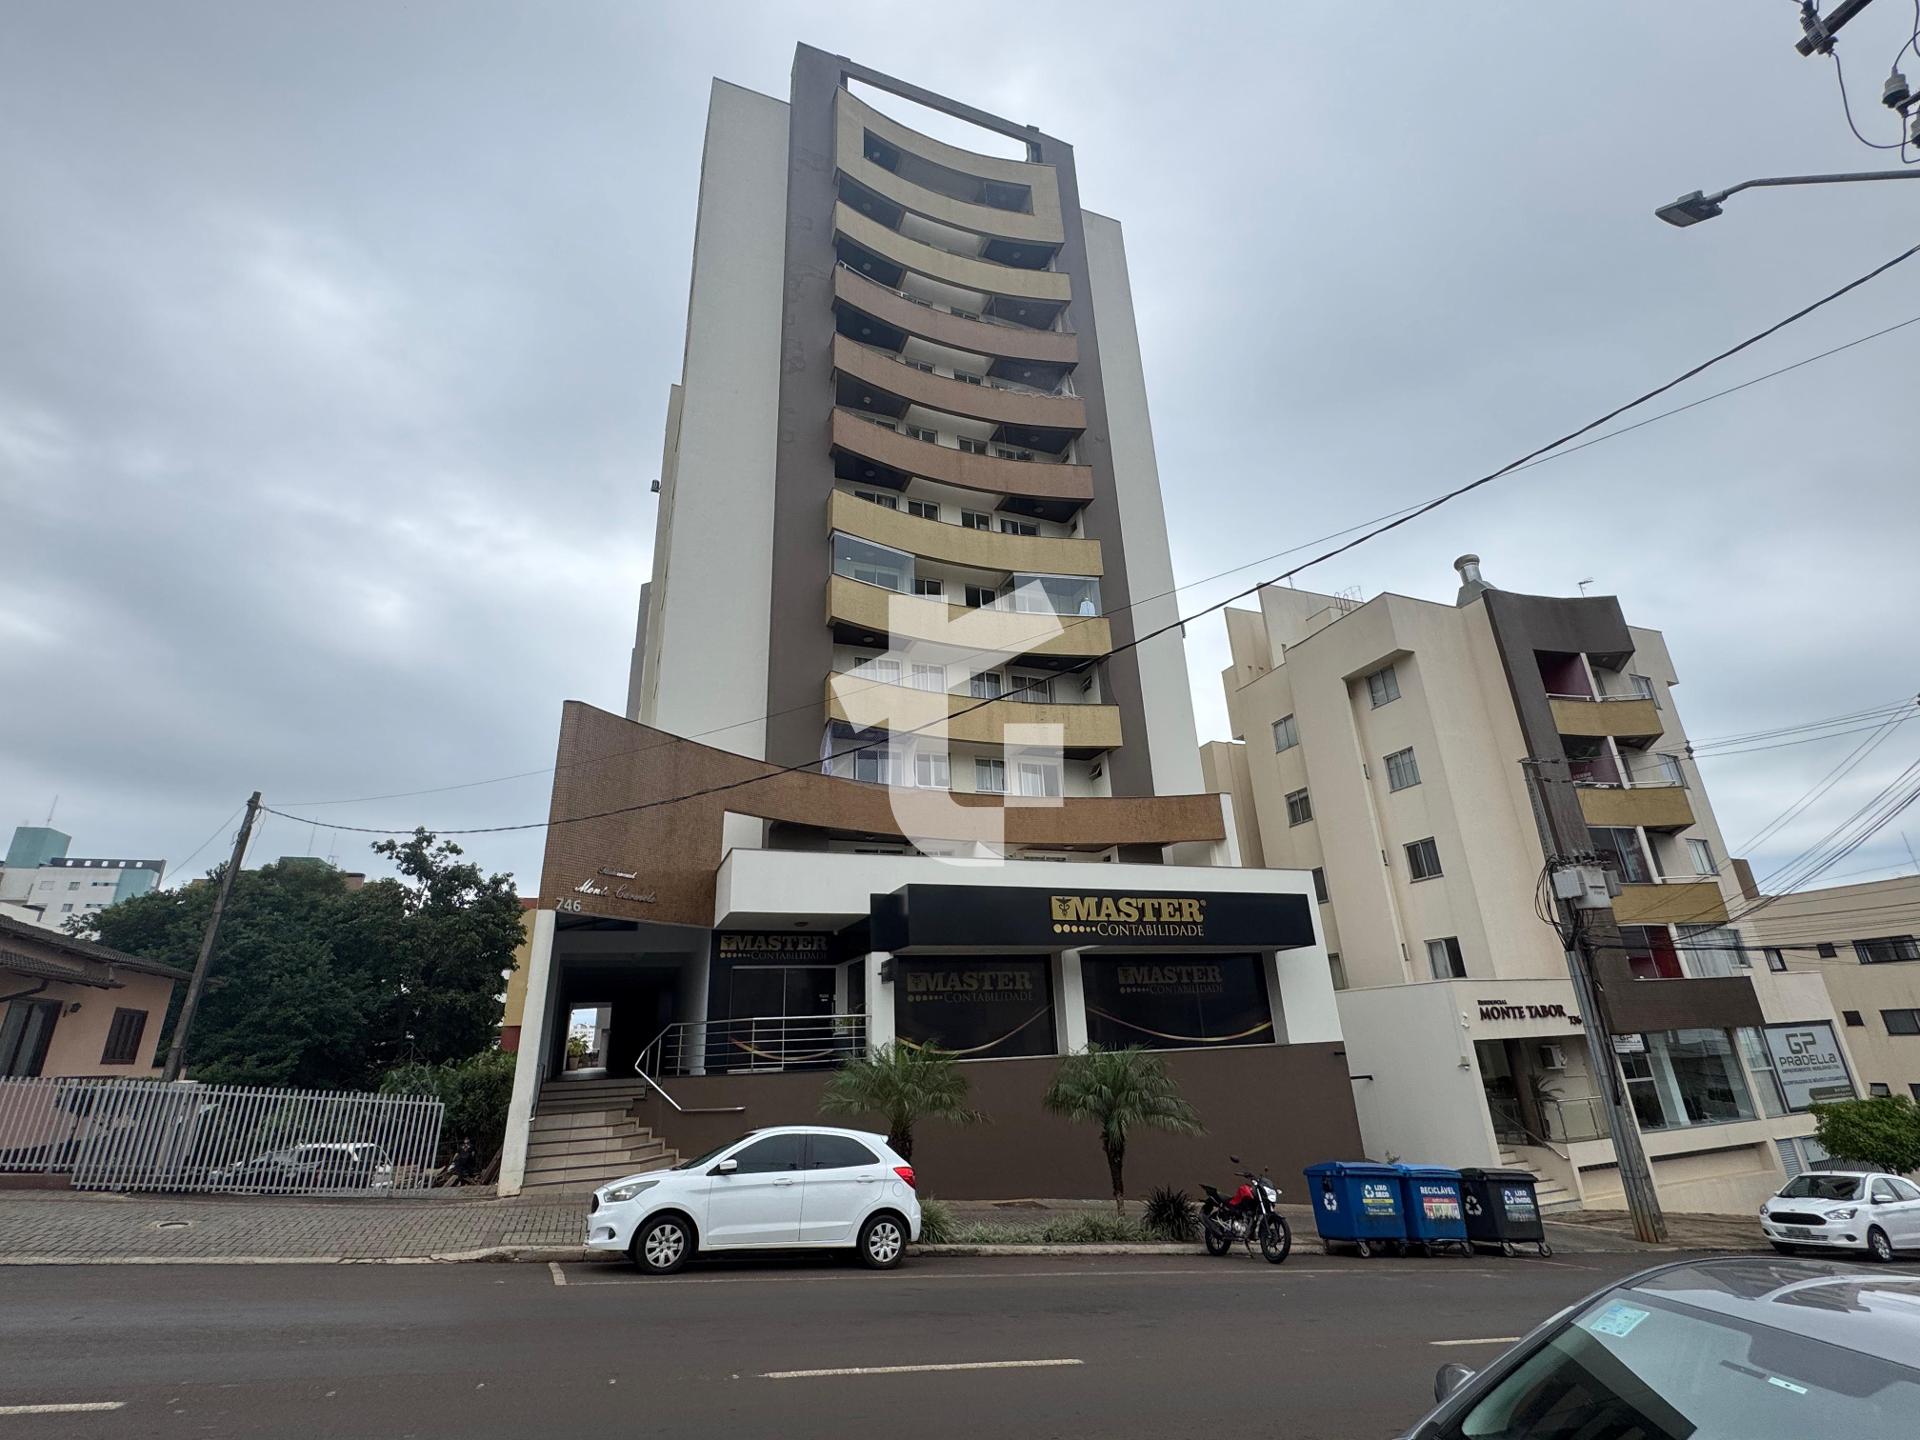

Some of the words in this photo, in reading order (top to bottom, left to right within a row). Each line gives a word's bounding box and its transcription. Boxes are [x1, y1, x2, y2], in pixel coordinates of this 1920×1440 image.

[556, 898, 582, 912] 746
[1072, 896, 1204, 923] MASTER
[735, 934, 829, 951] MASTER
[922, 971, 1033, 991] MASTER
[1134, 965, 1223, 984] MASTER
[1479, 1005, 1525, 1021] MONTE
[1525, 1004, 1567, 1019] TABOR
[1785, 1032, 1817, 1055] GP
